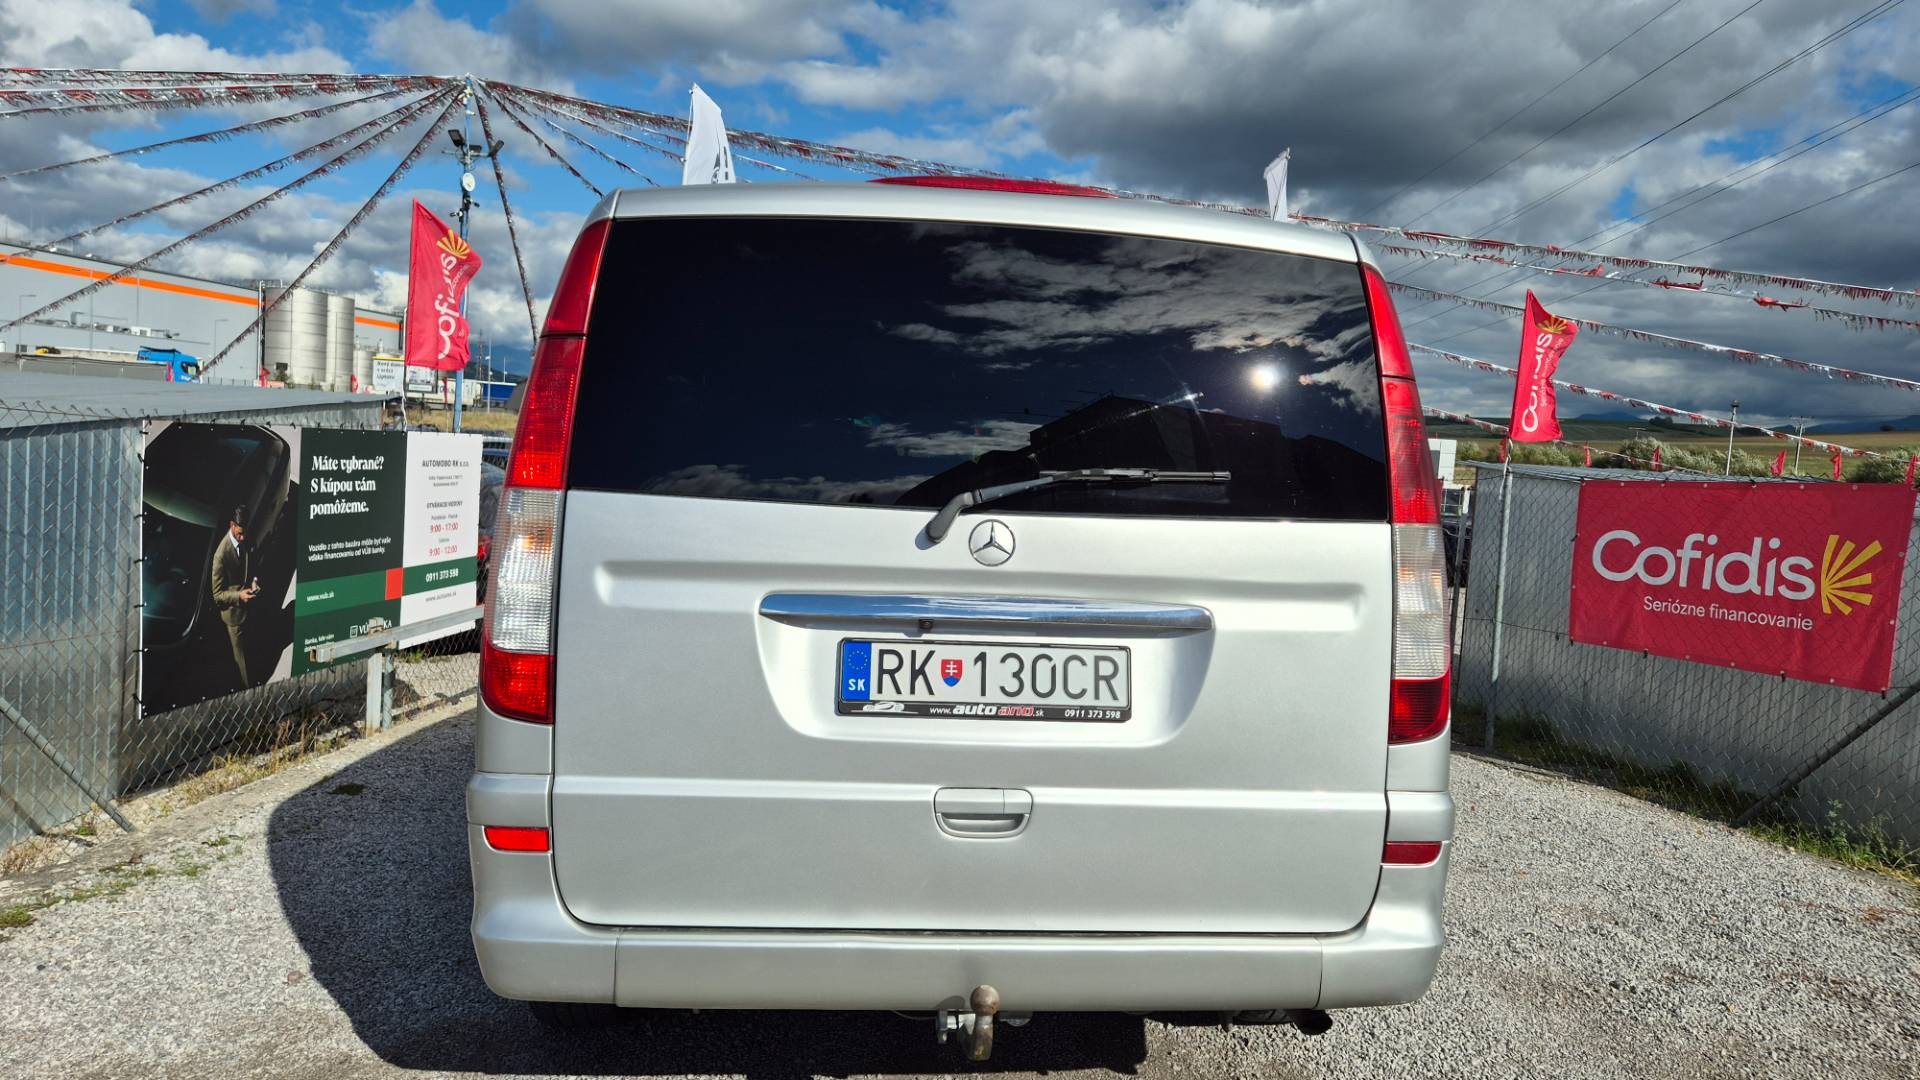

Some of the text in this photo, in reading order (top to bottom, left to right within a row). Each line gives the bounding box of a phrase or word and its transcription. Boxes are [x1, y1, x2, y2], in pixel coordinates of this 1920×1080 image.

[312, 455, 384, 473] Máte vybrané?
[311, 477, 376, 496] S kúpou vám
[310, 499, 369, 519] pomôžeme.
[430, 523, 441, 533] 9:00
[445, 522, 458, 532] 17:00
[429, 547, 440, 556] 9:00
[445, 545, 458, 554] 12:00
[1592, 530, 1816, 600] Cofidis
[425, 571, 438, 583] 0911
[1643, 596, 1813, 630] Seriózne financovanie
[876, 648, 1120, 701] RK 130CR
[848, 678, 865, 691] SK
[1064, 709, 1085, 718] 0911
[1087, 710, 1103, 718] 373
[1105, 710, 1121, 719] 598
